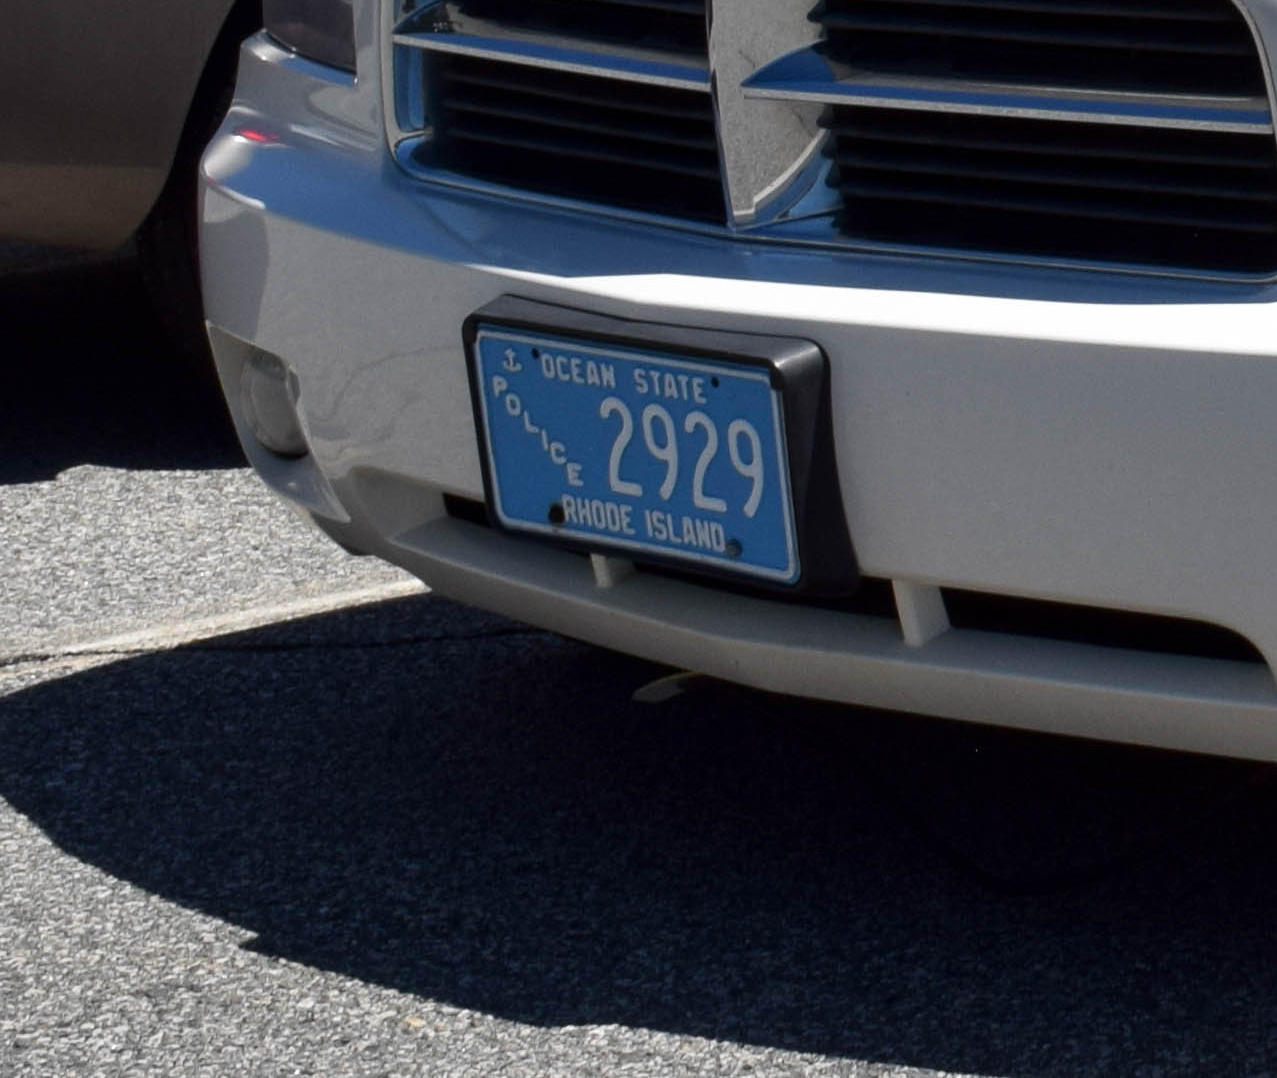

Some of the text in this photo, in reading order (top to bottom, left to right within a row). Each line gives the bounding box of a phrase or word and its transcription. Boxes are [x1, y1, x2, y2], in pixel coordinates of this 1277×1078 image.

[540, 352, 707, 404] OCEAN STATE
[492, 376, 584, 487] POLICE
[600, 396, 764, 519] 2929
[562, 494, 726, 553] RHODE ISLAND
